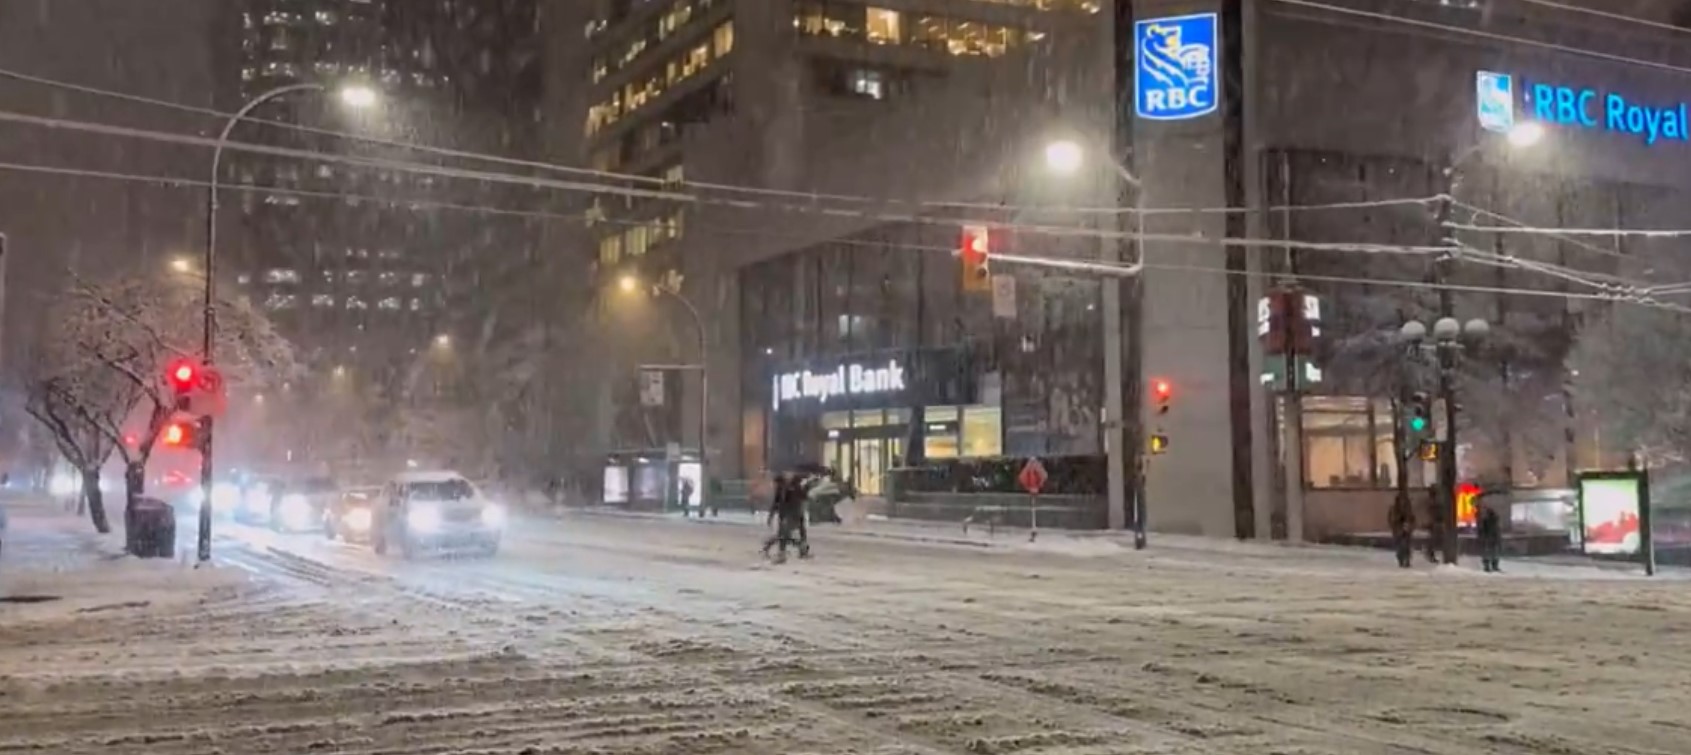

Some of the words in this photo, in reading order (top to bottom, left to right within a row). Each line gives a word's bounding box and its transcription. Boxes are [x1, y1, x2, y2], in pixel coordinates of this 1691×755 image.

[1145, 85, 1209, 112] RBC
[1533, 83, 1598, 127] RBC
[1606, 92, 1689, 145] Royal
[802, 364, 846, 403] Royal
[849, 359, 905, 394] Bank
